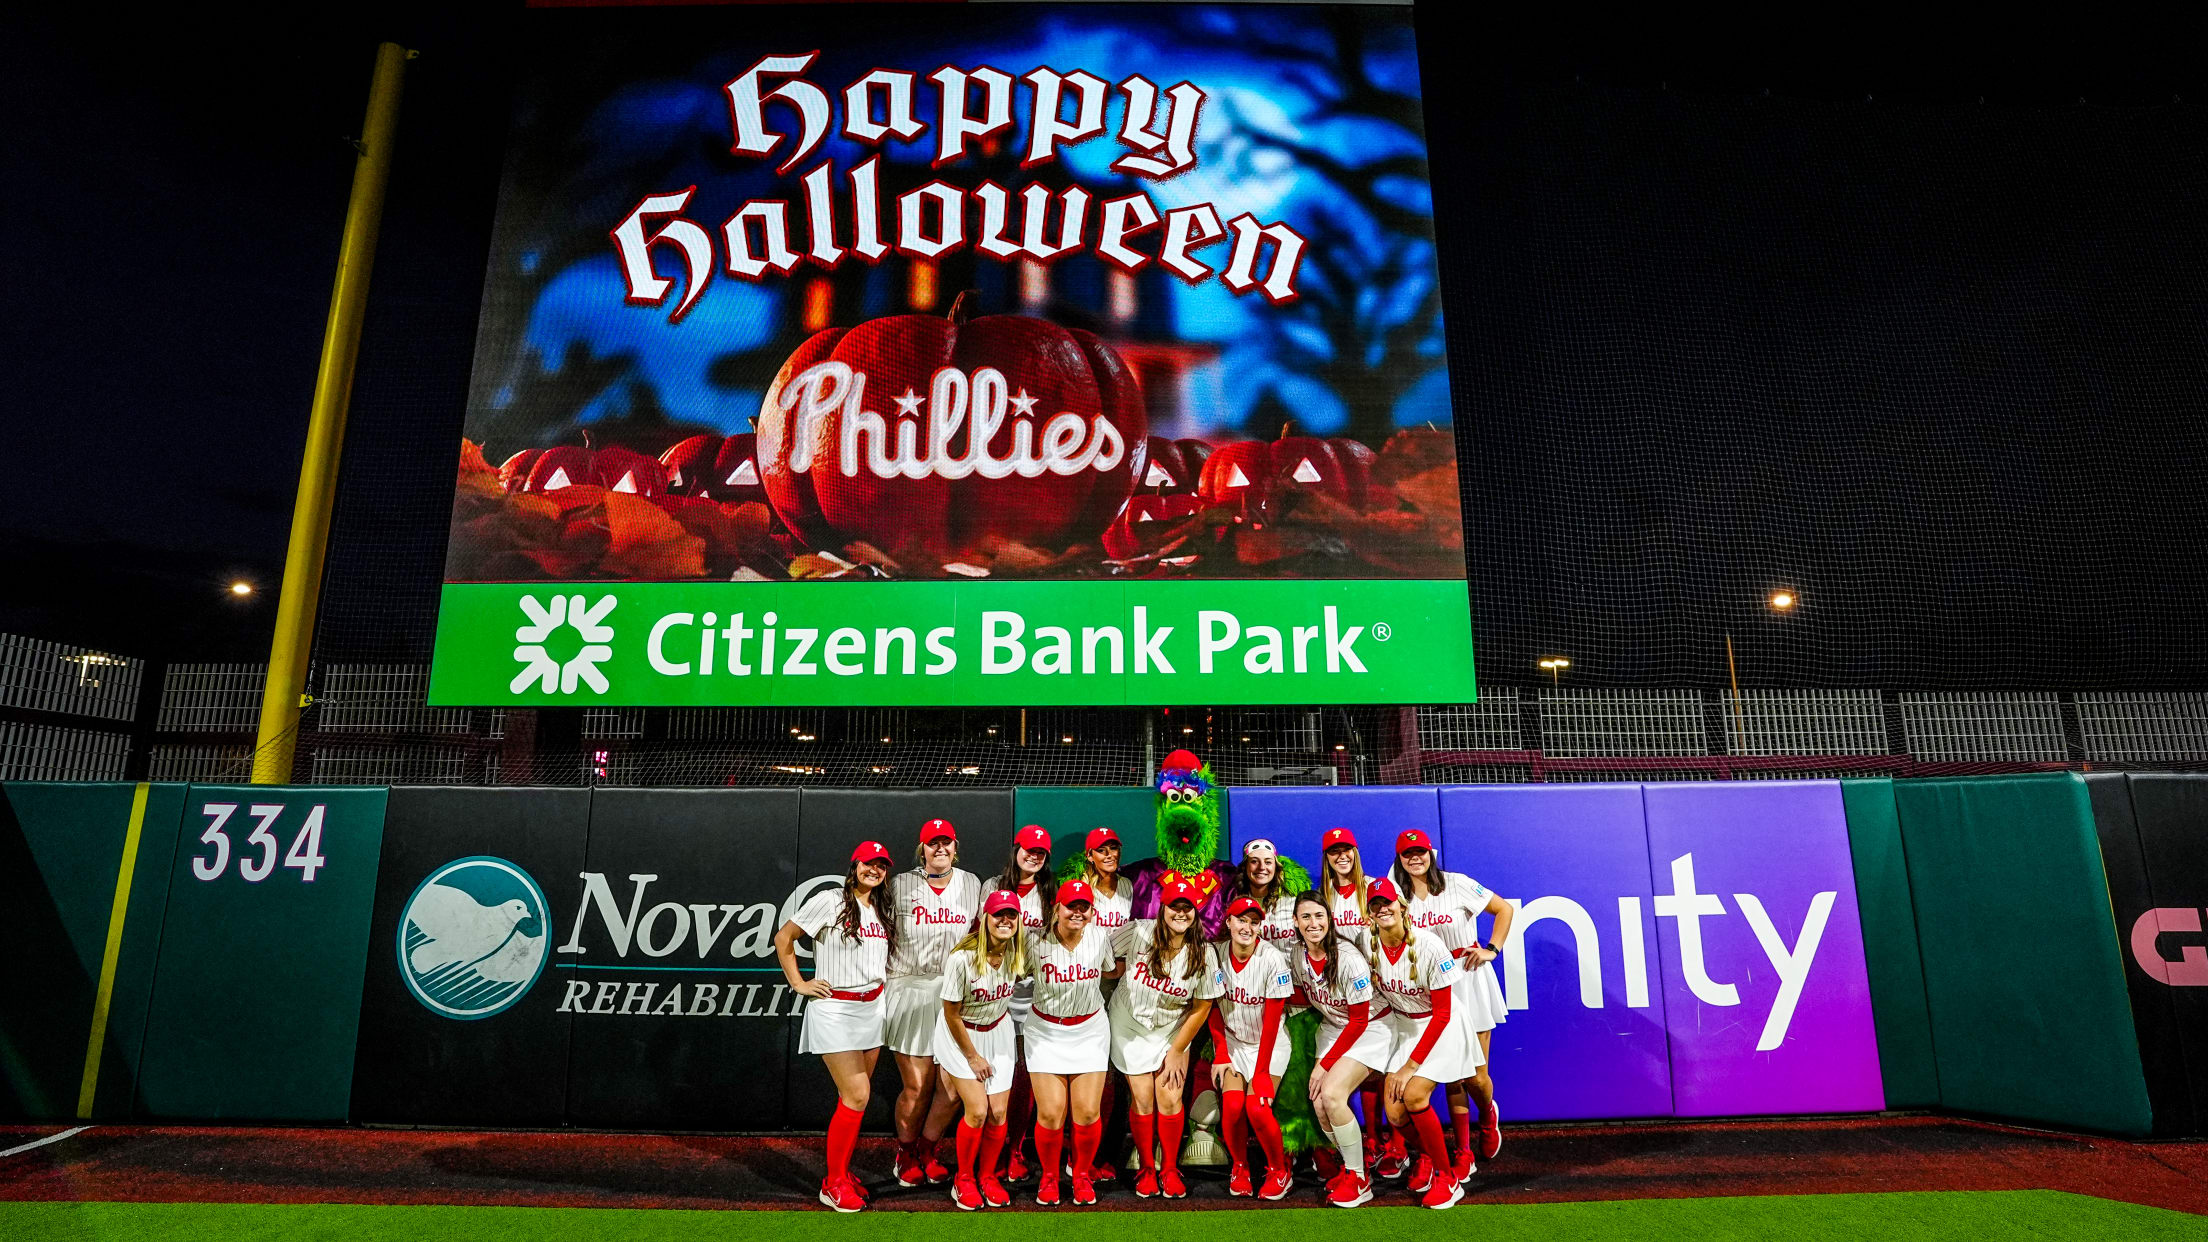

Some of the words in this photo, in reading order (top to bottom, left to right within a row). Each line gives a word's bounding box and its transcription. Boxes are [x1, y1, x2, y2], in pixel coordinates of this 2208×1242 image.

[725, 51, 1206, 181] Happy
[610, 154, 1307, 323] Halloween
[778, 359, 1126, 481] Phillies
[646, 611, 958, 677] Citizens
[980, 605, 1177, 676] Bank
[192, 802, 328, 884] 334
[556, 872, 846, 959] NovaC
[911, 905, 967, 926] Phillies
[1409, 911, 1453, 929] hillies
[1502, 851, 1838, 1051] nity
[556, 979, 806, 1017] REHABILIT
[1041, 963, 1100, 984] Phillies
